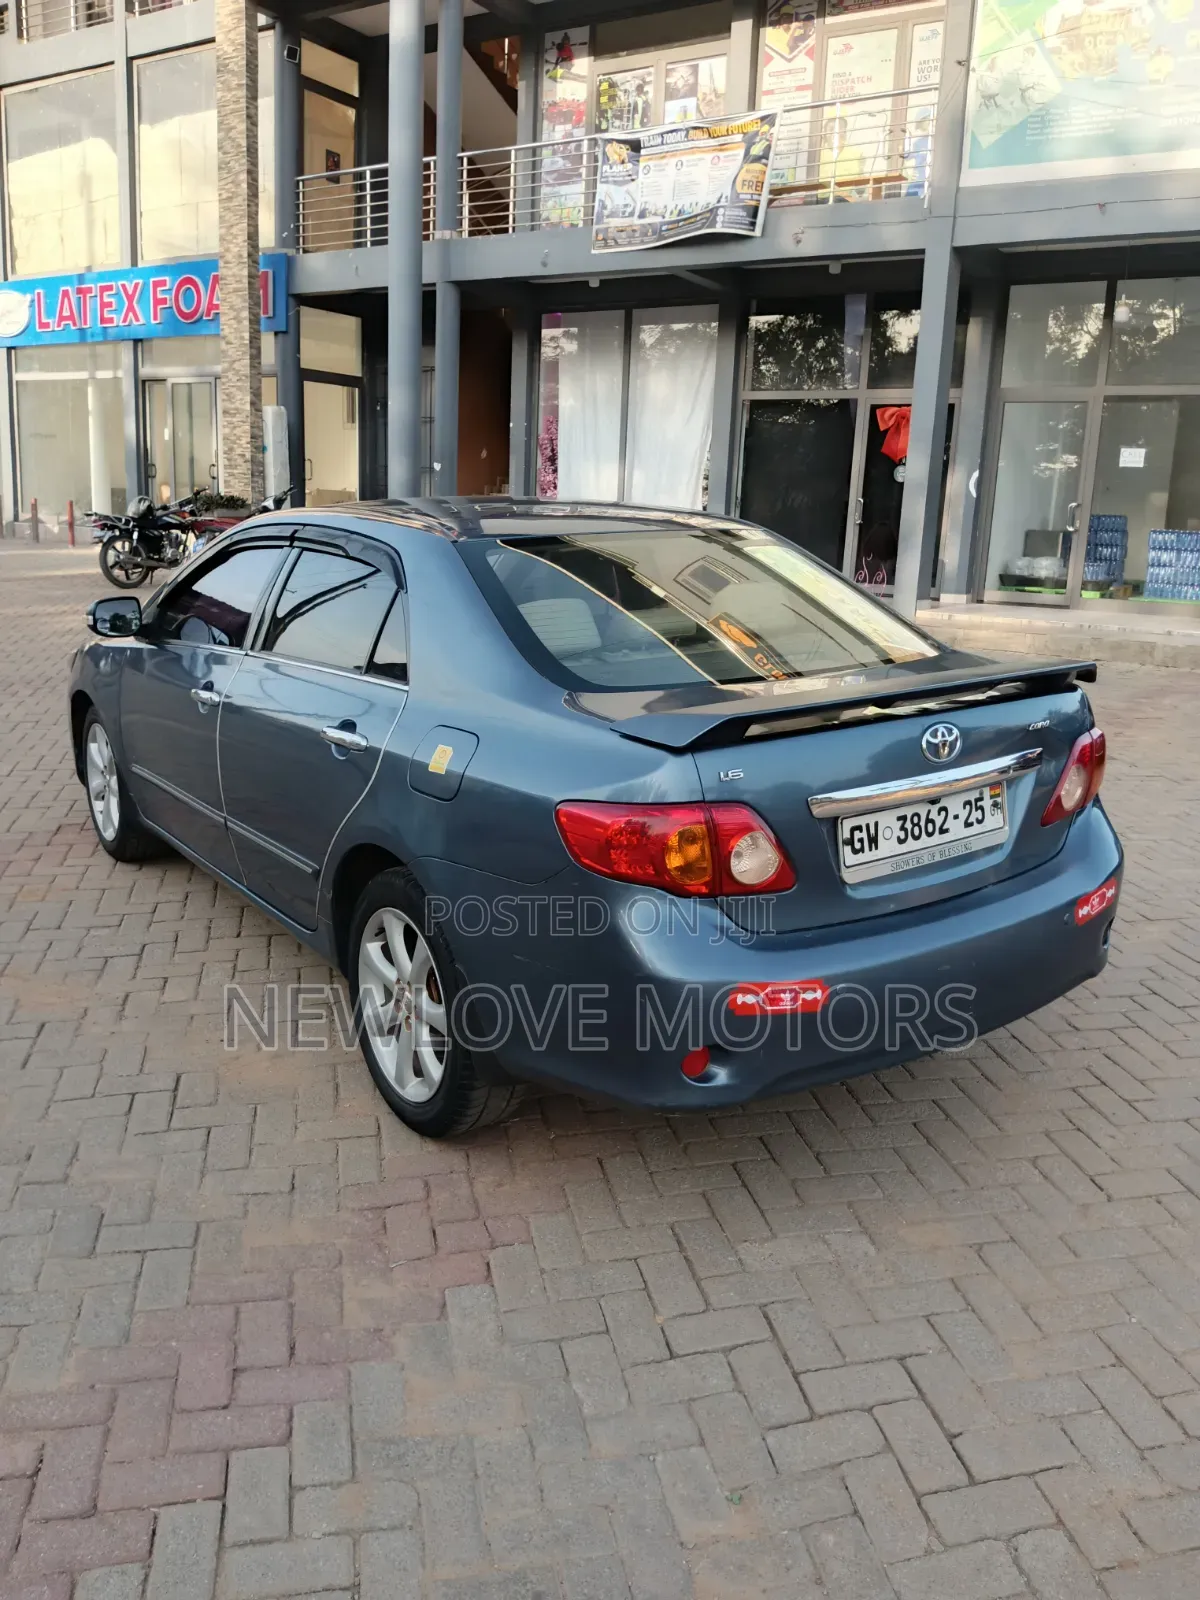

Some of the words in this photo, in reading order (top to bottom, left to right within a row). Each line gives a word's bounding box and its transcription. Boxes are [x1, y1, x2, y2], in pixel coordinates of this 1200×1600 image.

[916, 75, 931, 83] US!
[917, 65, 941, 75] WOR
[832, 76, 873, 87] DISPATCH
[663, 129, 688, 146] TODAY.
[710, 124, 728, 140] YOUR
[34, 279, 144, 332] LATEX
[850, 820, 880, 856] GW
[896, 795, 986, 846] 3862-25
[891, 854, 925, 872] SHOWERS
[927, 851, 936, 862] OF
[939, 842, 973, 859] BLESSING
